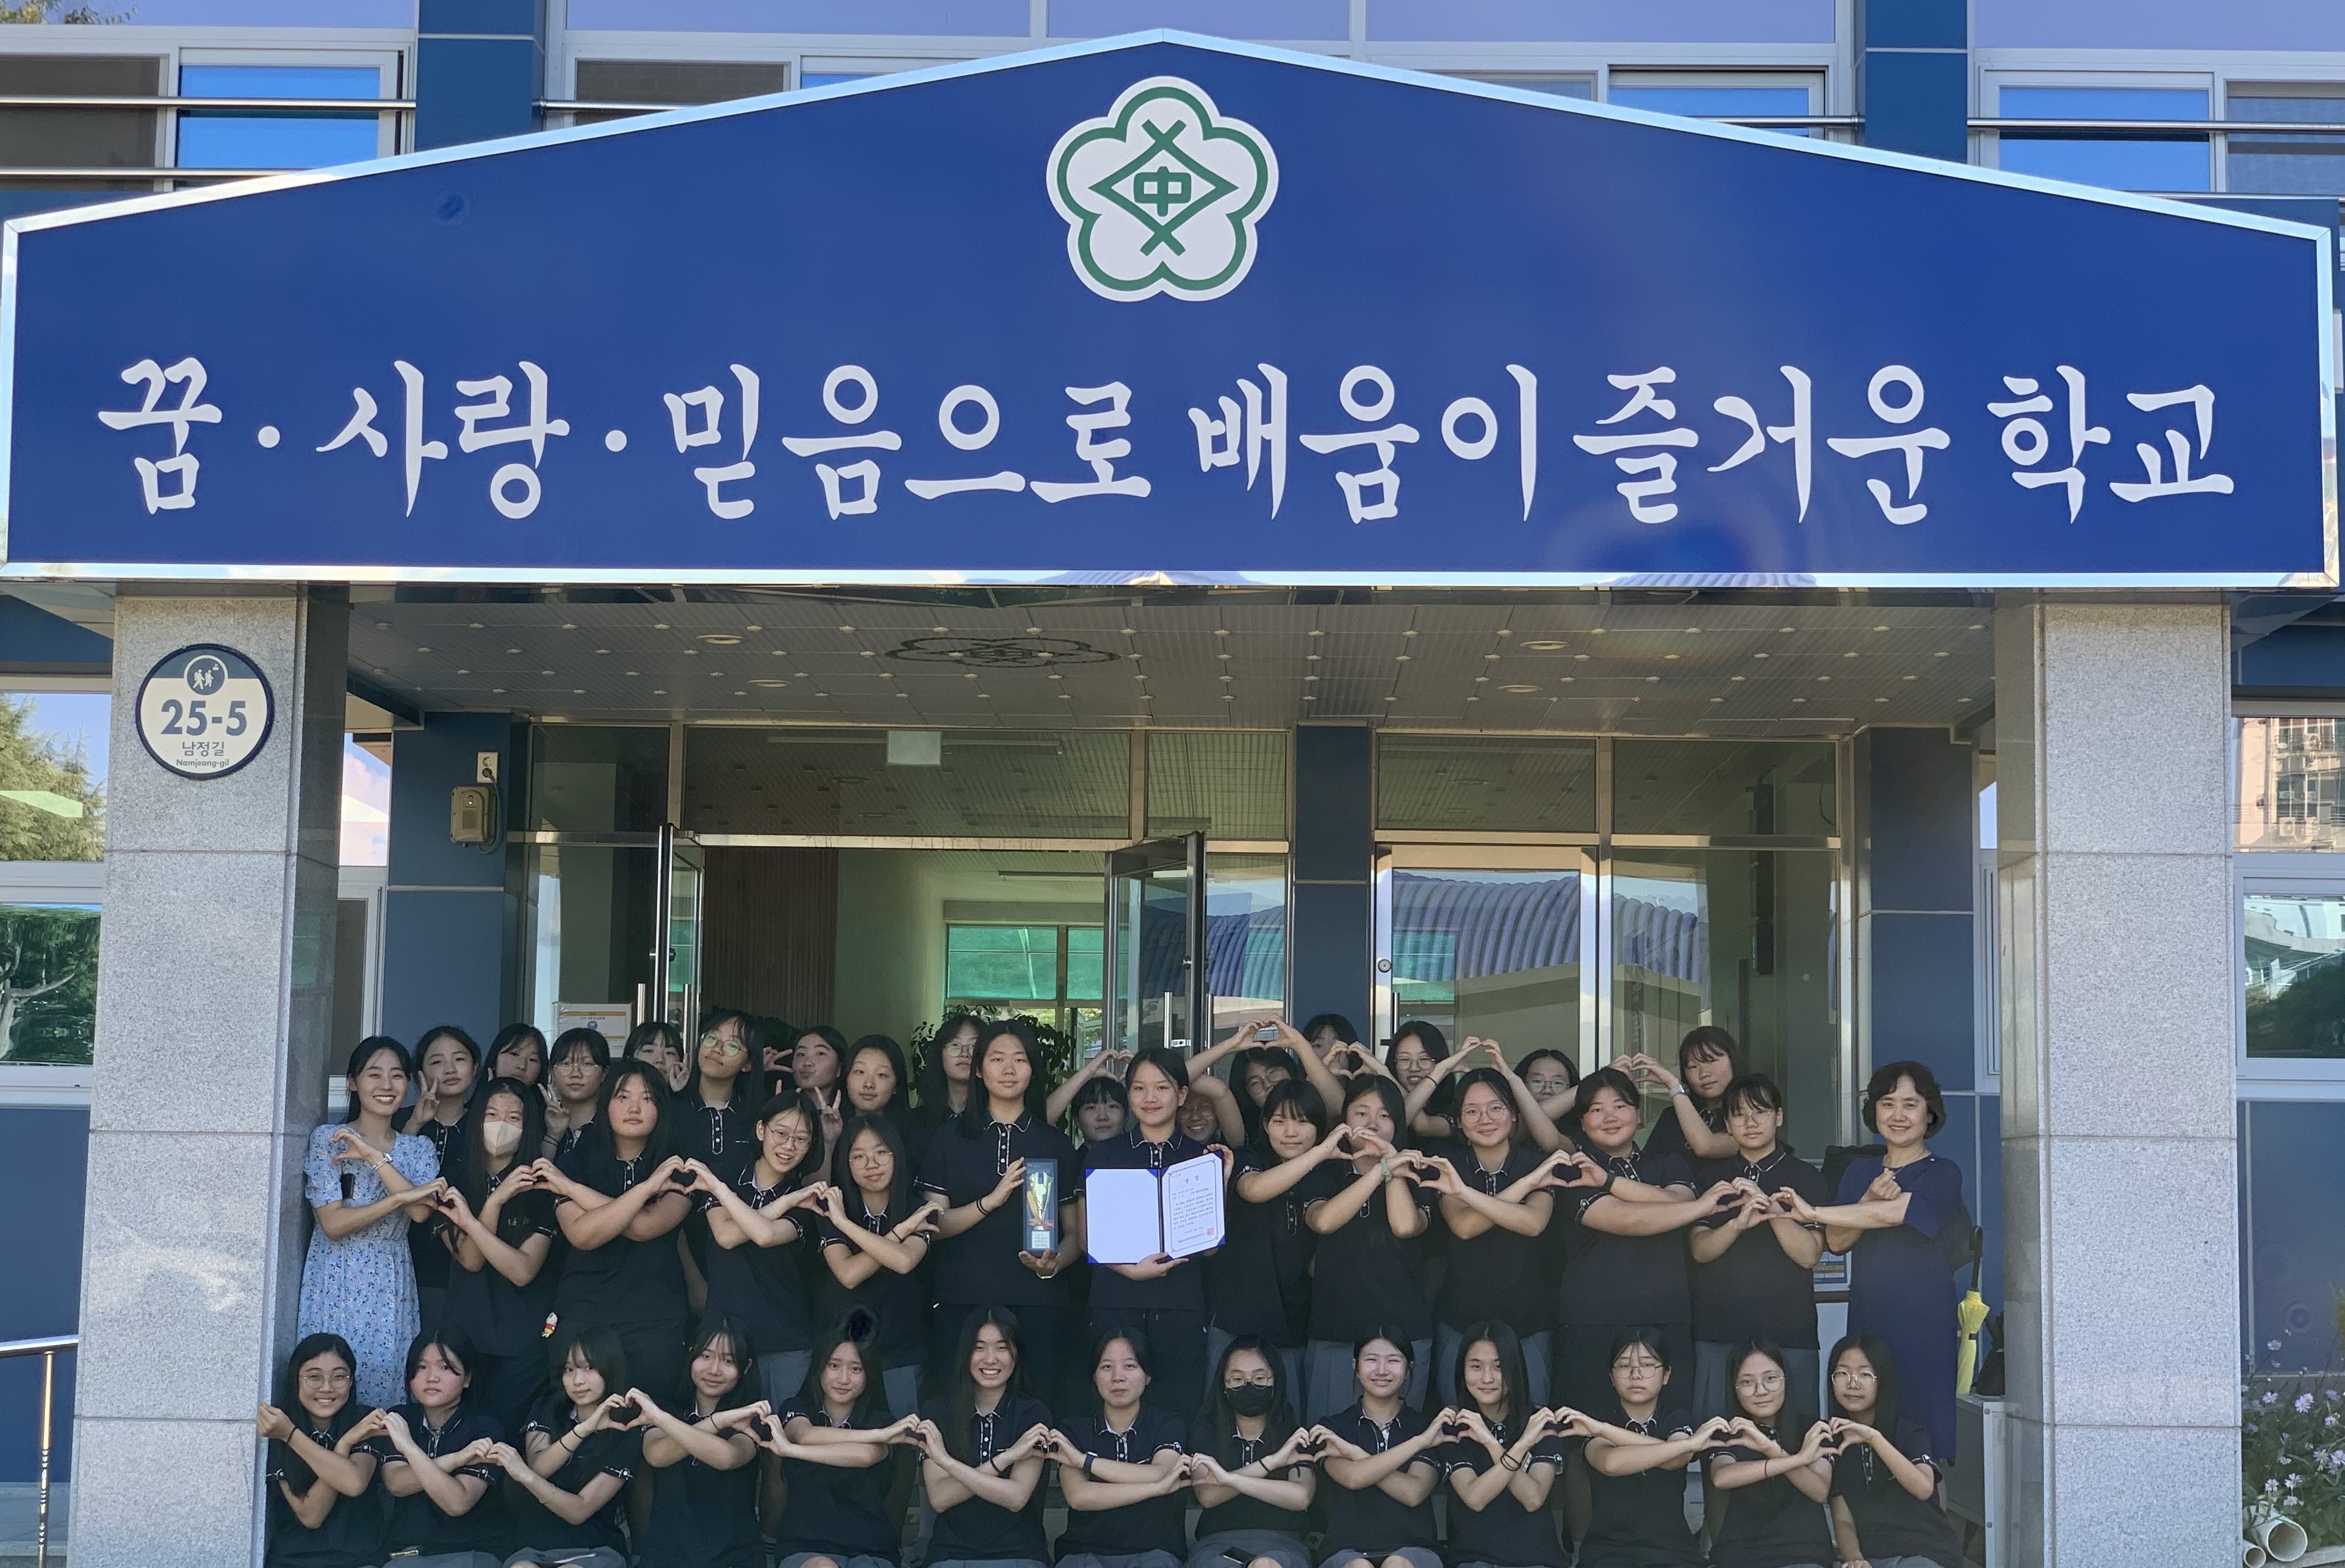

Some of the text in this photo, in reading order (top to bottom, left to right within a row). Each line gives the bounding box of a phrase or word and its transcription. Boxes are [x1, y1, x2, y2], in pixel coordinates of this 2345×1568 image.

[1133, 165, 1192, 217] 中
[1187, 363, 1537, 525] 배움이
[1572, 365, 1950, 525] 즐거운
[1987, 365, 2235, 524] 학교
[160, 699, 247, 736] 25-5
[176, 758, 229, 768] Namjeong-gil
[182, 741, 225, 757] 남정길
